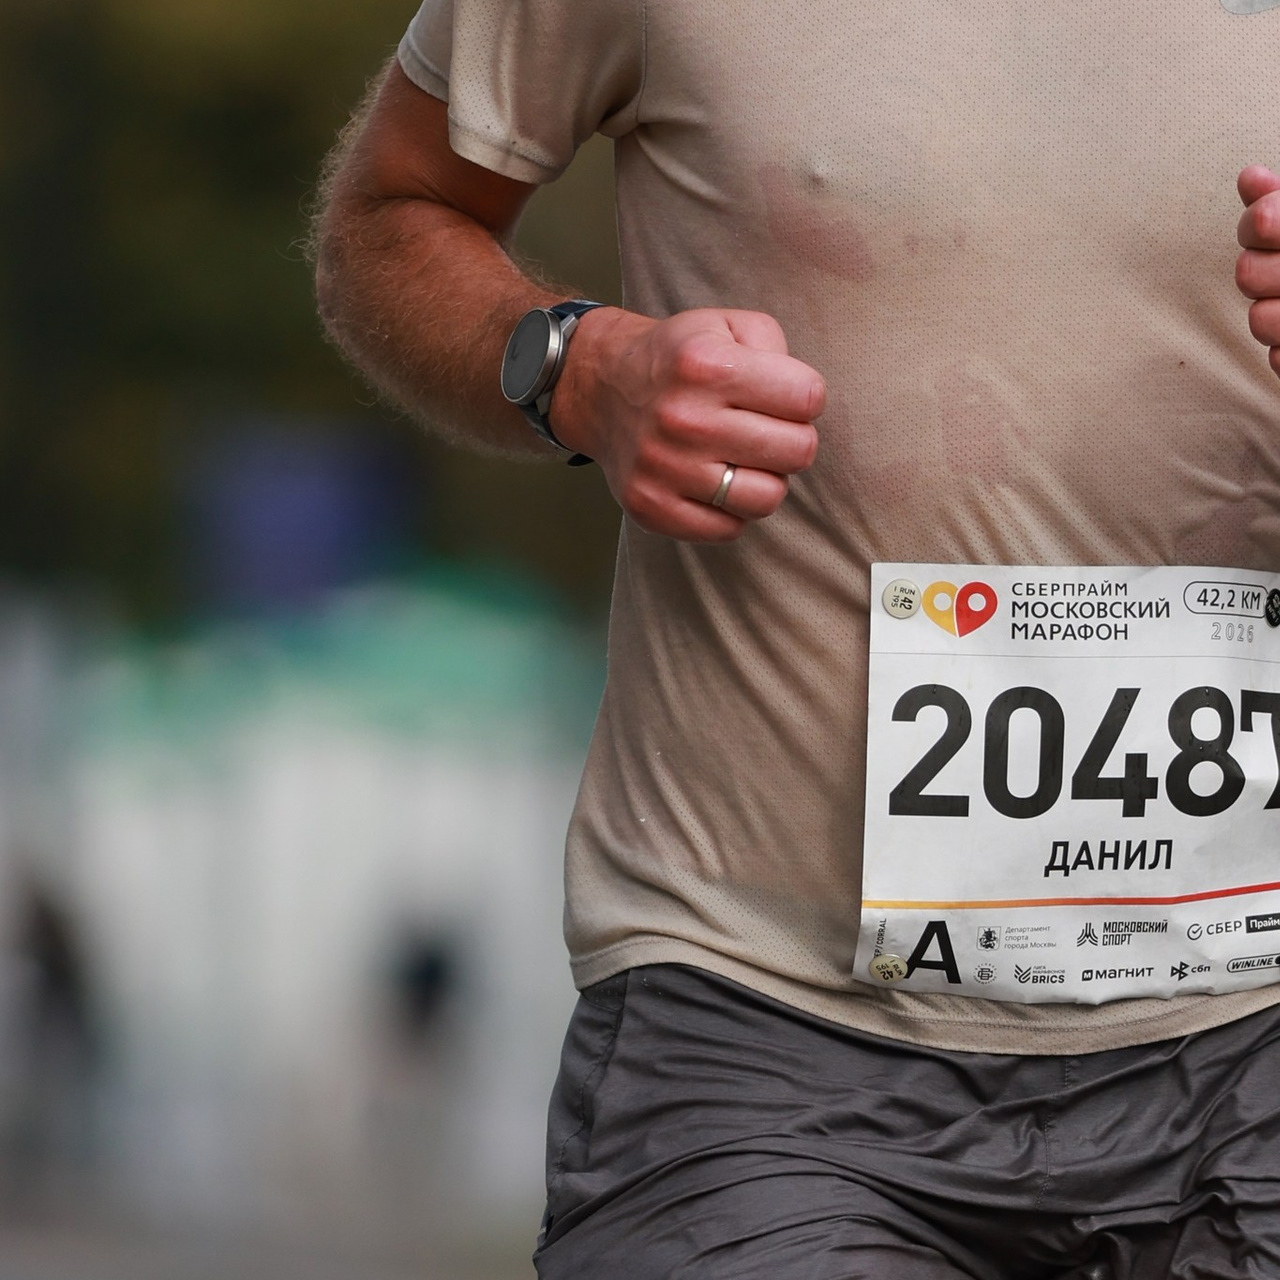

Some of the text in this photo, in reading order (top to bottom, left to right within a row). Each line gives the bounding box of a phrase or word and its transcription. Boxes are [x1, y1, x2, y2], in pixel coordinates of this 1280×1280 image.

[899, 586, 916, 596] RUN
[1012, 580, 1128, 597] СБЕРПРАЙМ
[1197, 588, 1236, 610] 42,2
[1242, 590, 1261, 611] КМ
[1012, 597, 1171, 619] МОСКОВСКИЙ
[1011, 622, 1129, 641] МАРАФОН
[1043, 839, 1174, 878] ДАНИЛ
[1005, 926, 1051, 934] Департамент
[1103, 919, 1168, 933] МОСКОВСКИЙ
[1206, 917, 1280, 936] СБЕР Прайм
[1102, 933, 1133, 946] СПОРТ
[1191, 965, 1211, 974] сбп
[1231, 957, 1274, 970] WINLINE
[1031, 974, 1065, 984] BRICS
[1095, 967, 1154, 980] магнит
